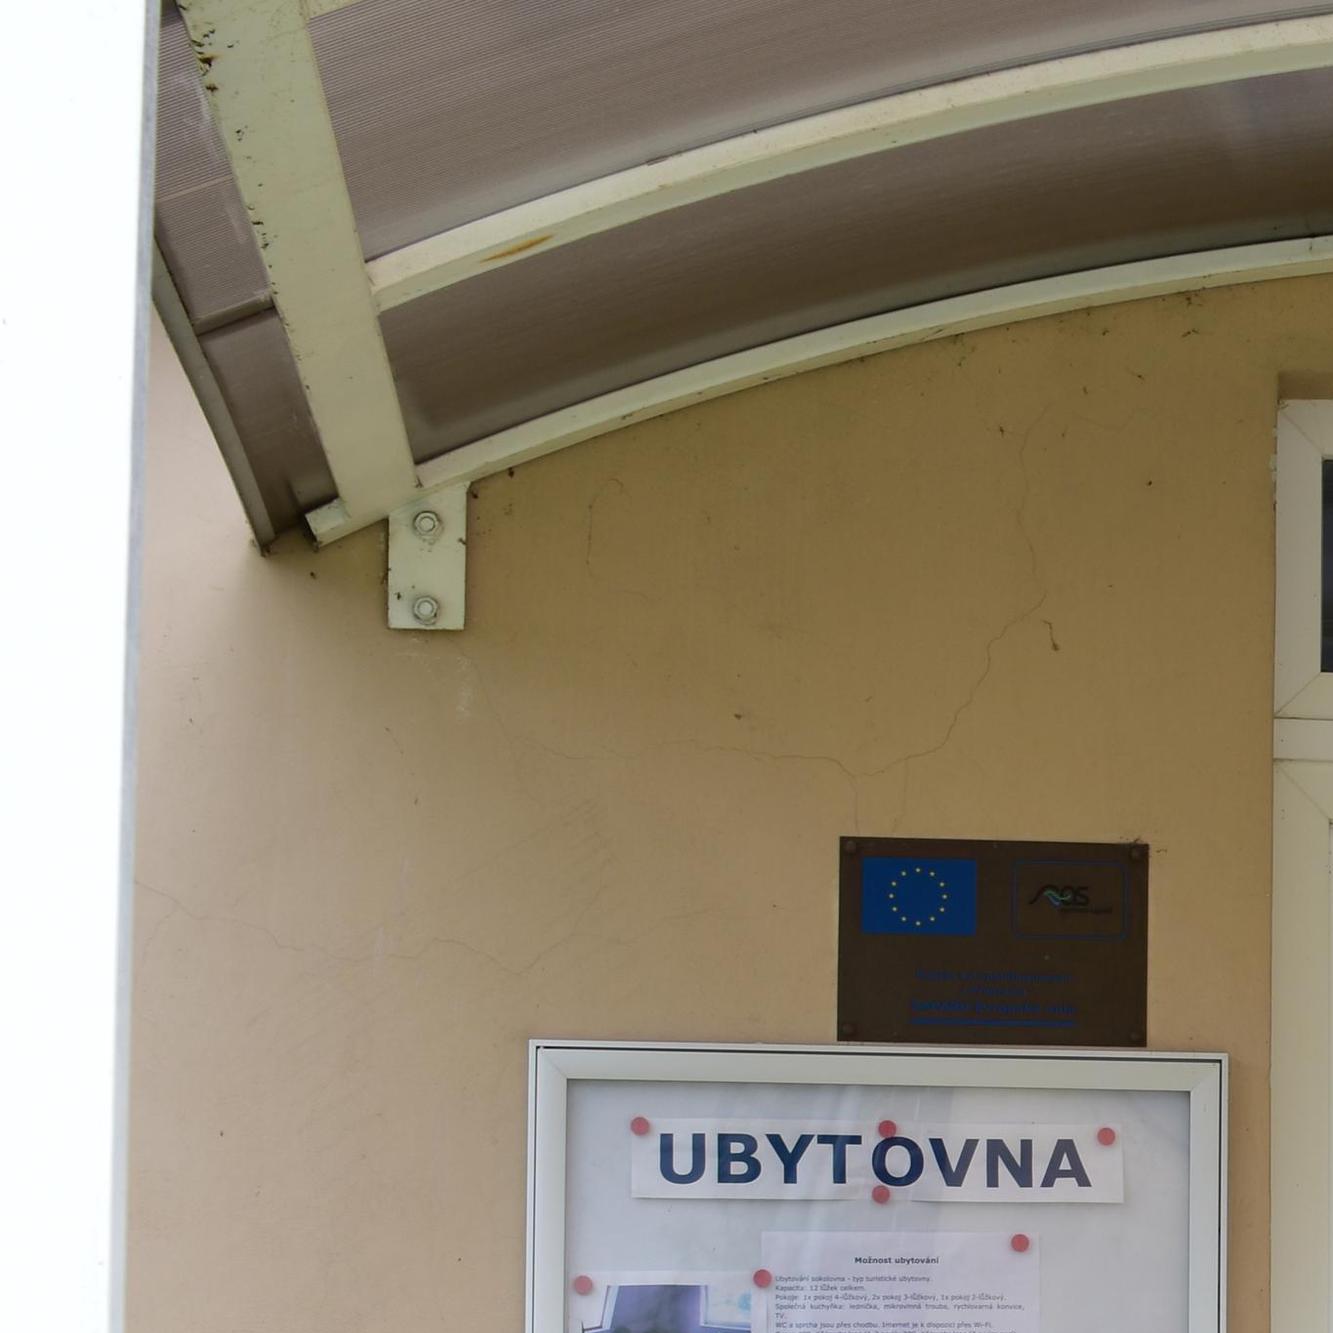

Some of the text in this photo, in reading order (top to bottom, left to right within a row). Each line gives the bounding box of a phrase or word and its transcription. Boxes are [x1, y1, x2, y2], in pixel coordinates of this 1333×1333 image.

[657, 1131, 1093, 1189] UBYTOVNA
[855, 1257, 939, 1265] Možnost ubytování
